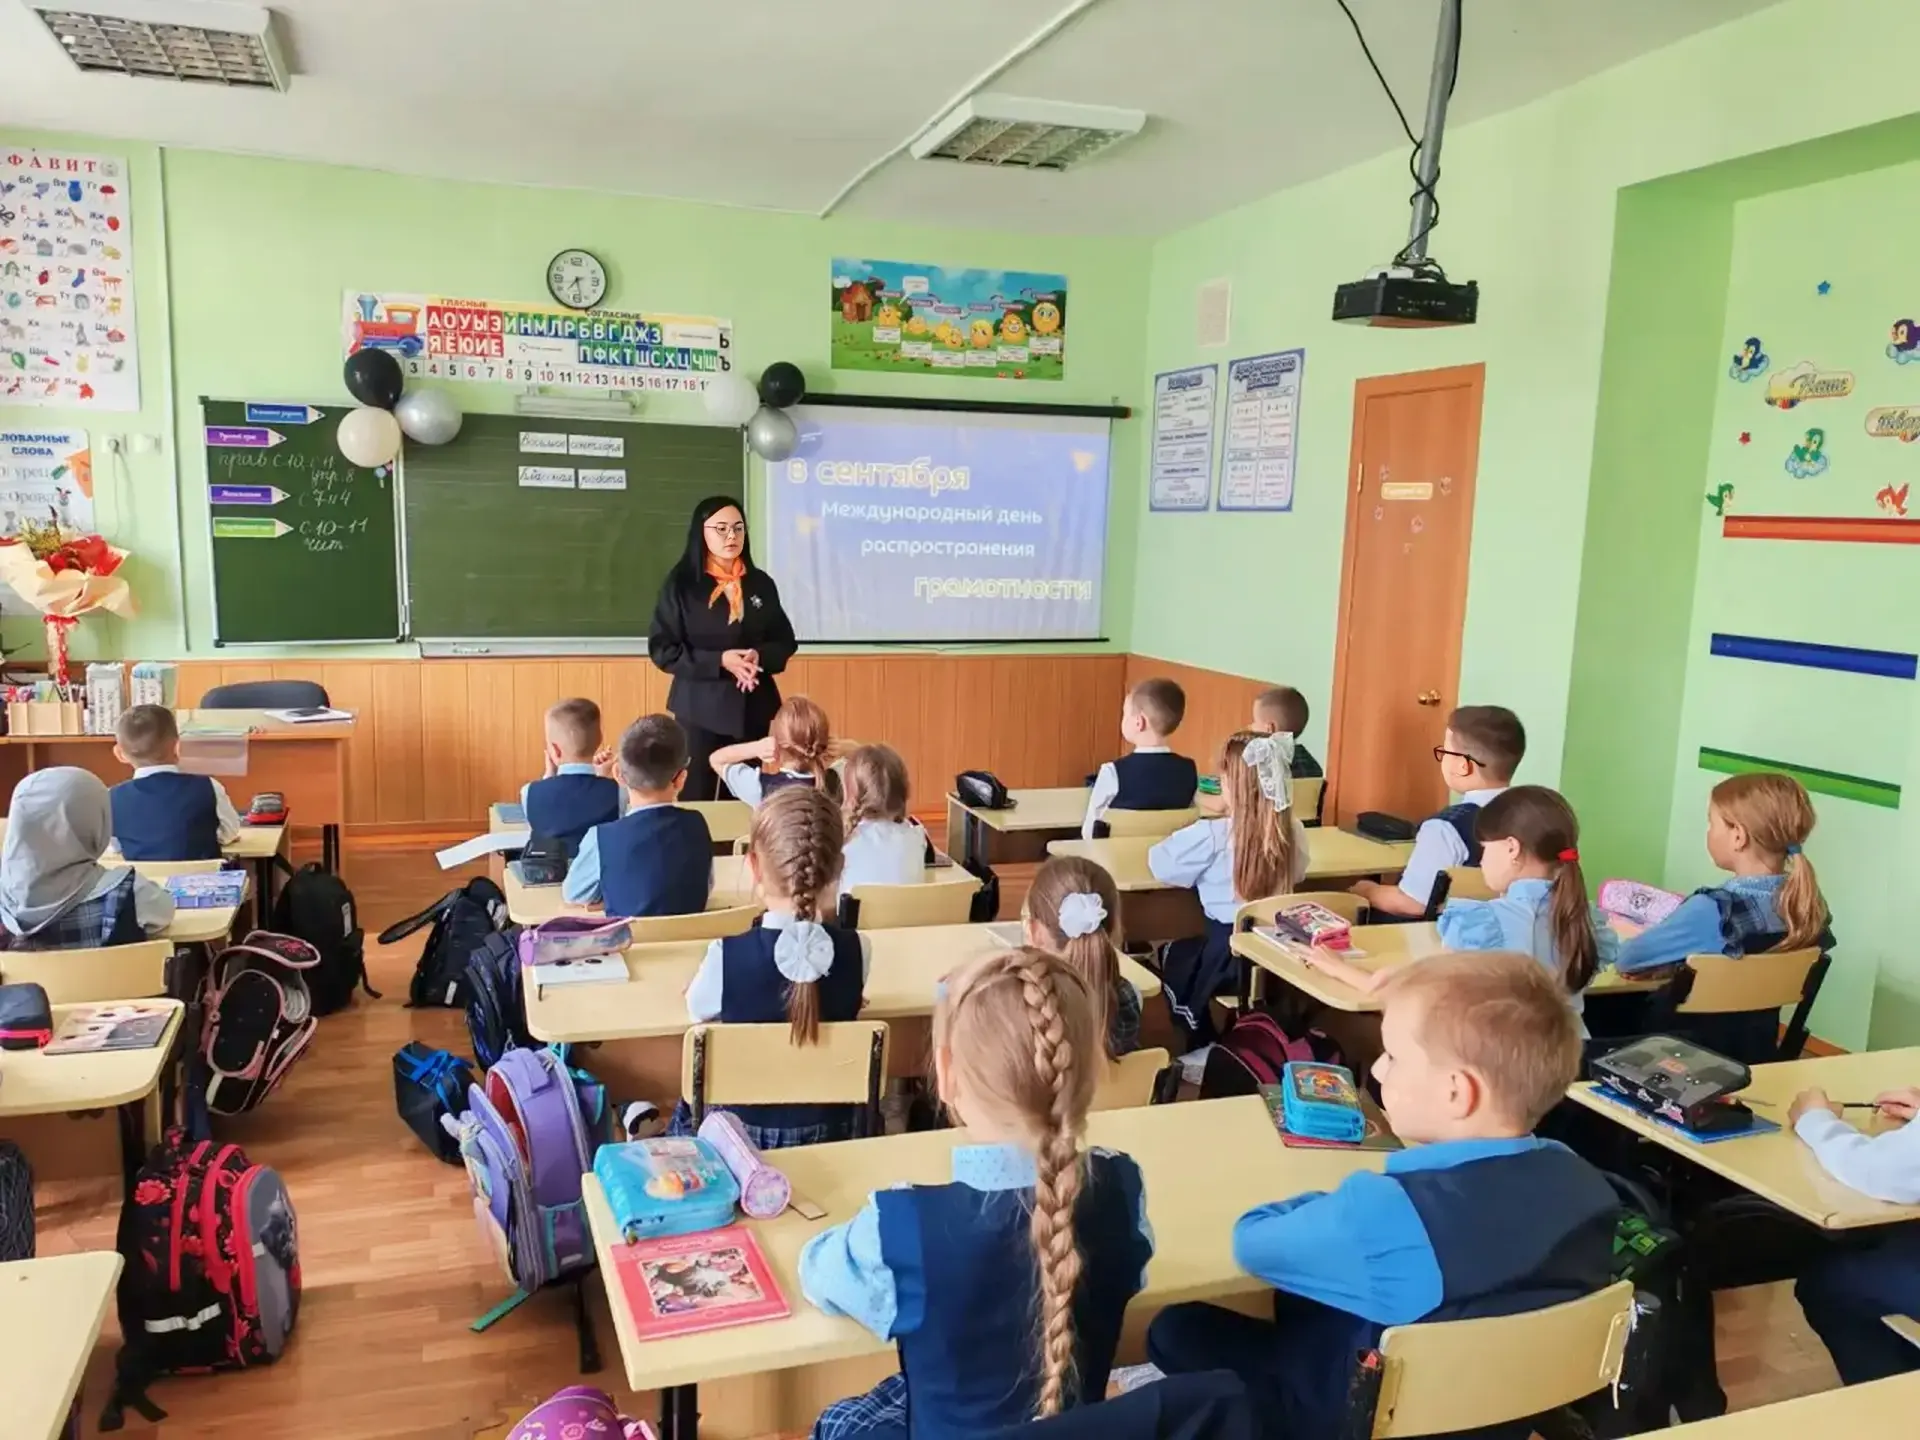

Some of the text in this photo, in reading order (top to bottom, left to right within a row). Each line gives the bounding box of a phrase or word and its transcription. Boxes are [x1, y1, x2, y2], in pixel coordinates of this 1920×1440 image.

[410, 363, 418, 374] 3
[429, 364, 438, 374] 4
[450, 365, 457, 376] 5
[468, 366, 476, 377] 6
[486, 367, 494, 378] 7
[506, 368, 513, 380] 8
[524, 369, 532, 381] 9
[540, 370, 554, 381] 10
[560, 371, 572, 382] 11
[577, 373, 591, 384] 12
[595, 374, 608, 385] 13
[613, 375, 626, 386] 14
[630, 376, 644, 387] 15
[648, 377, 661, 388] 16
[666, 378, 678, 390] 17
[682, 380, 696, 391] 18
[12, 446, 54, 456] СЛОВА
[816, 456, 971, 498] сентября
[822, 501, 1043, 526] Международный день
[861, 537, 1035, 558] распространения
[914, 576, 1092, 604] грамотности
